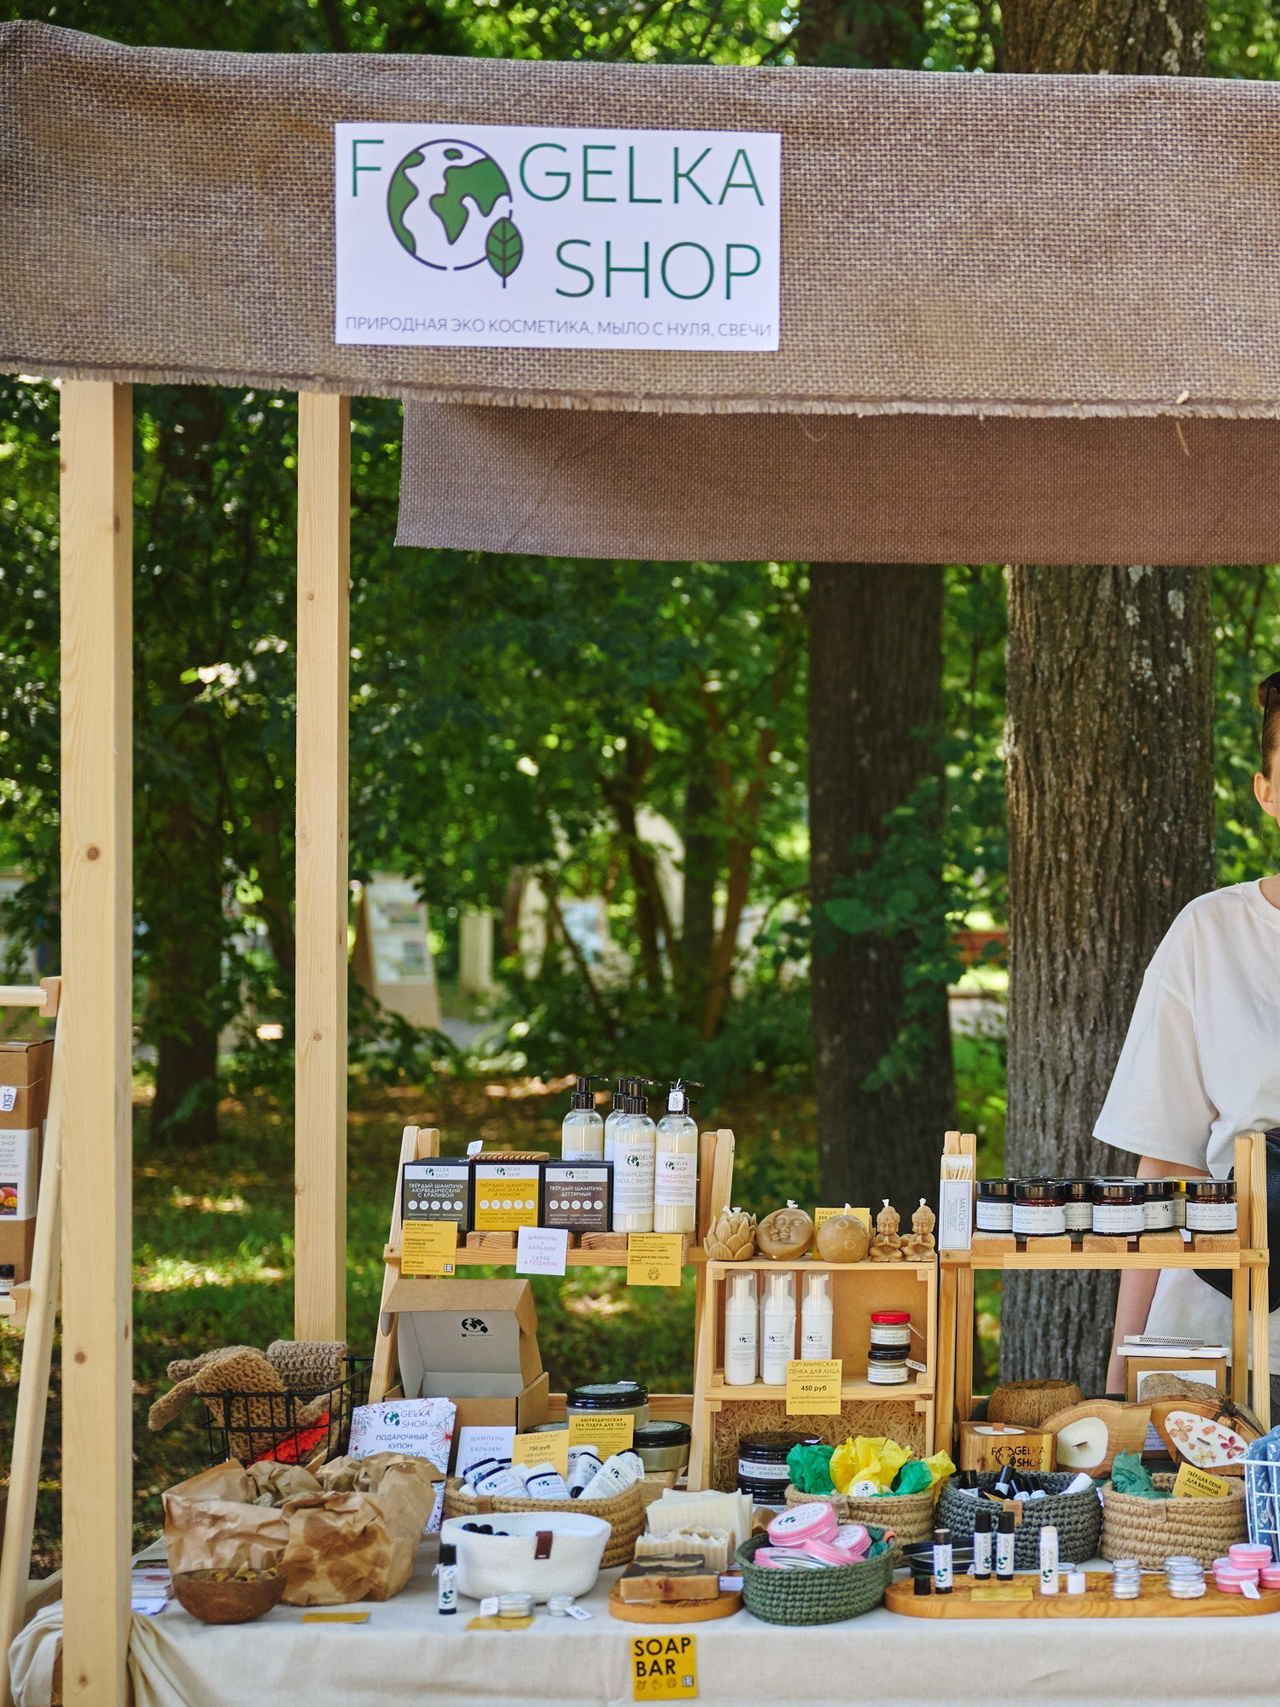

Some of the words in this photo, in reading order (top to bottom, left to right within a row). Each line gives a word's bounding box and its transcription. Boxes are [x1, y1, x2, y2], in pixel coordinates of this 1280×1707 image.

[554, 238, 763, 301] SHOP
[345, 316, 448, 333] ПРИРОДНАЯ
[451, 318, 486, 333] ЭКО
[598, 320, 650, 336] МЫЛО
[652, 322, 664, 336] С
[717, 323, 771, 337] СВЕЧИ
[813, 1384, 828, 1393] руб
[401, 1420, 428, 1428] SHOP
[375, 1433, 428, 1441] ПОДАРОЧНЫЙ
[520, 1433, 560, 1442] ДЕЗОДОРАНТ
[387, 1442, 413, 1450] КУПОН
[1016, 1457, 1044, 1468] SHOP
[1186, 1477, 1197, 1485] ДЛЯ
[1197, 1482, 1219, 1495] ВАННОЙ
[1208, 1480, 1222, 1490] ПЕНА
[634, 1637, 692, 1657] SOAP
[636, 1659, 676, 1677] BAR
